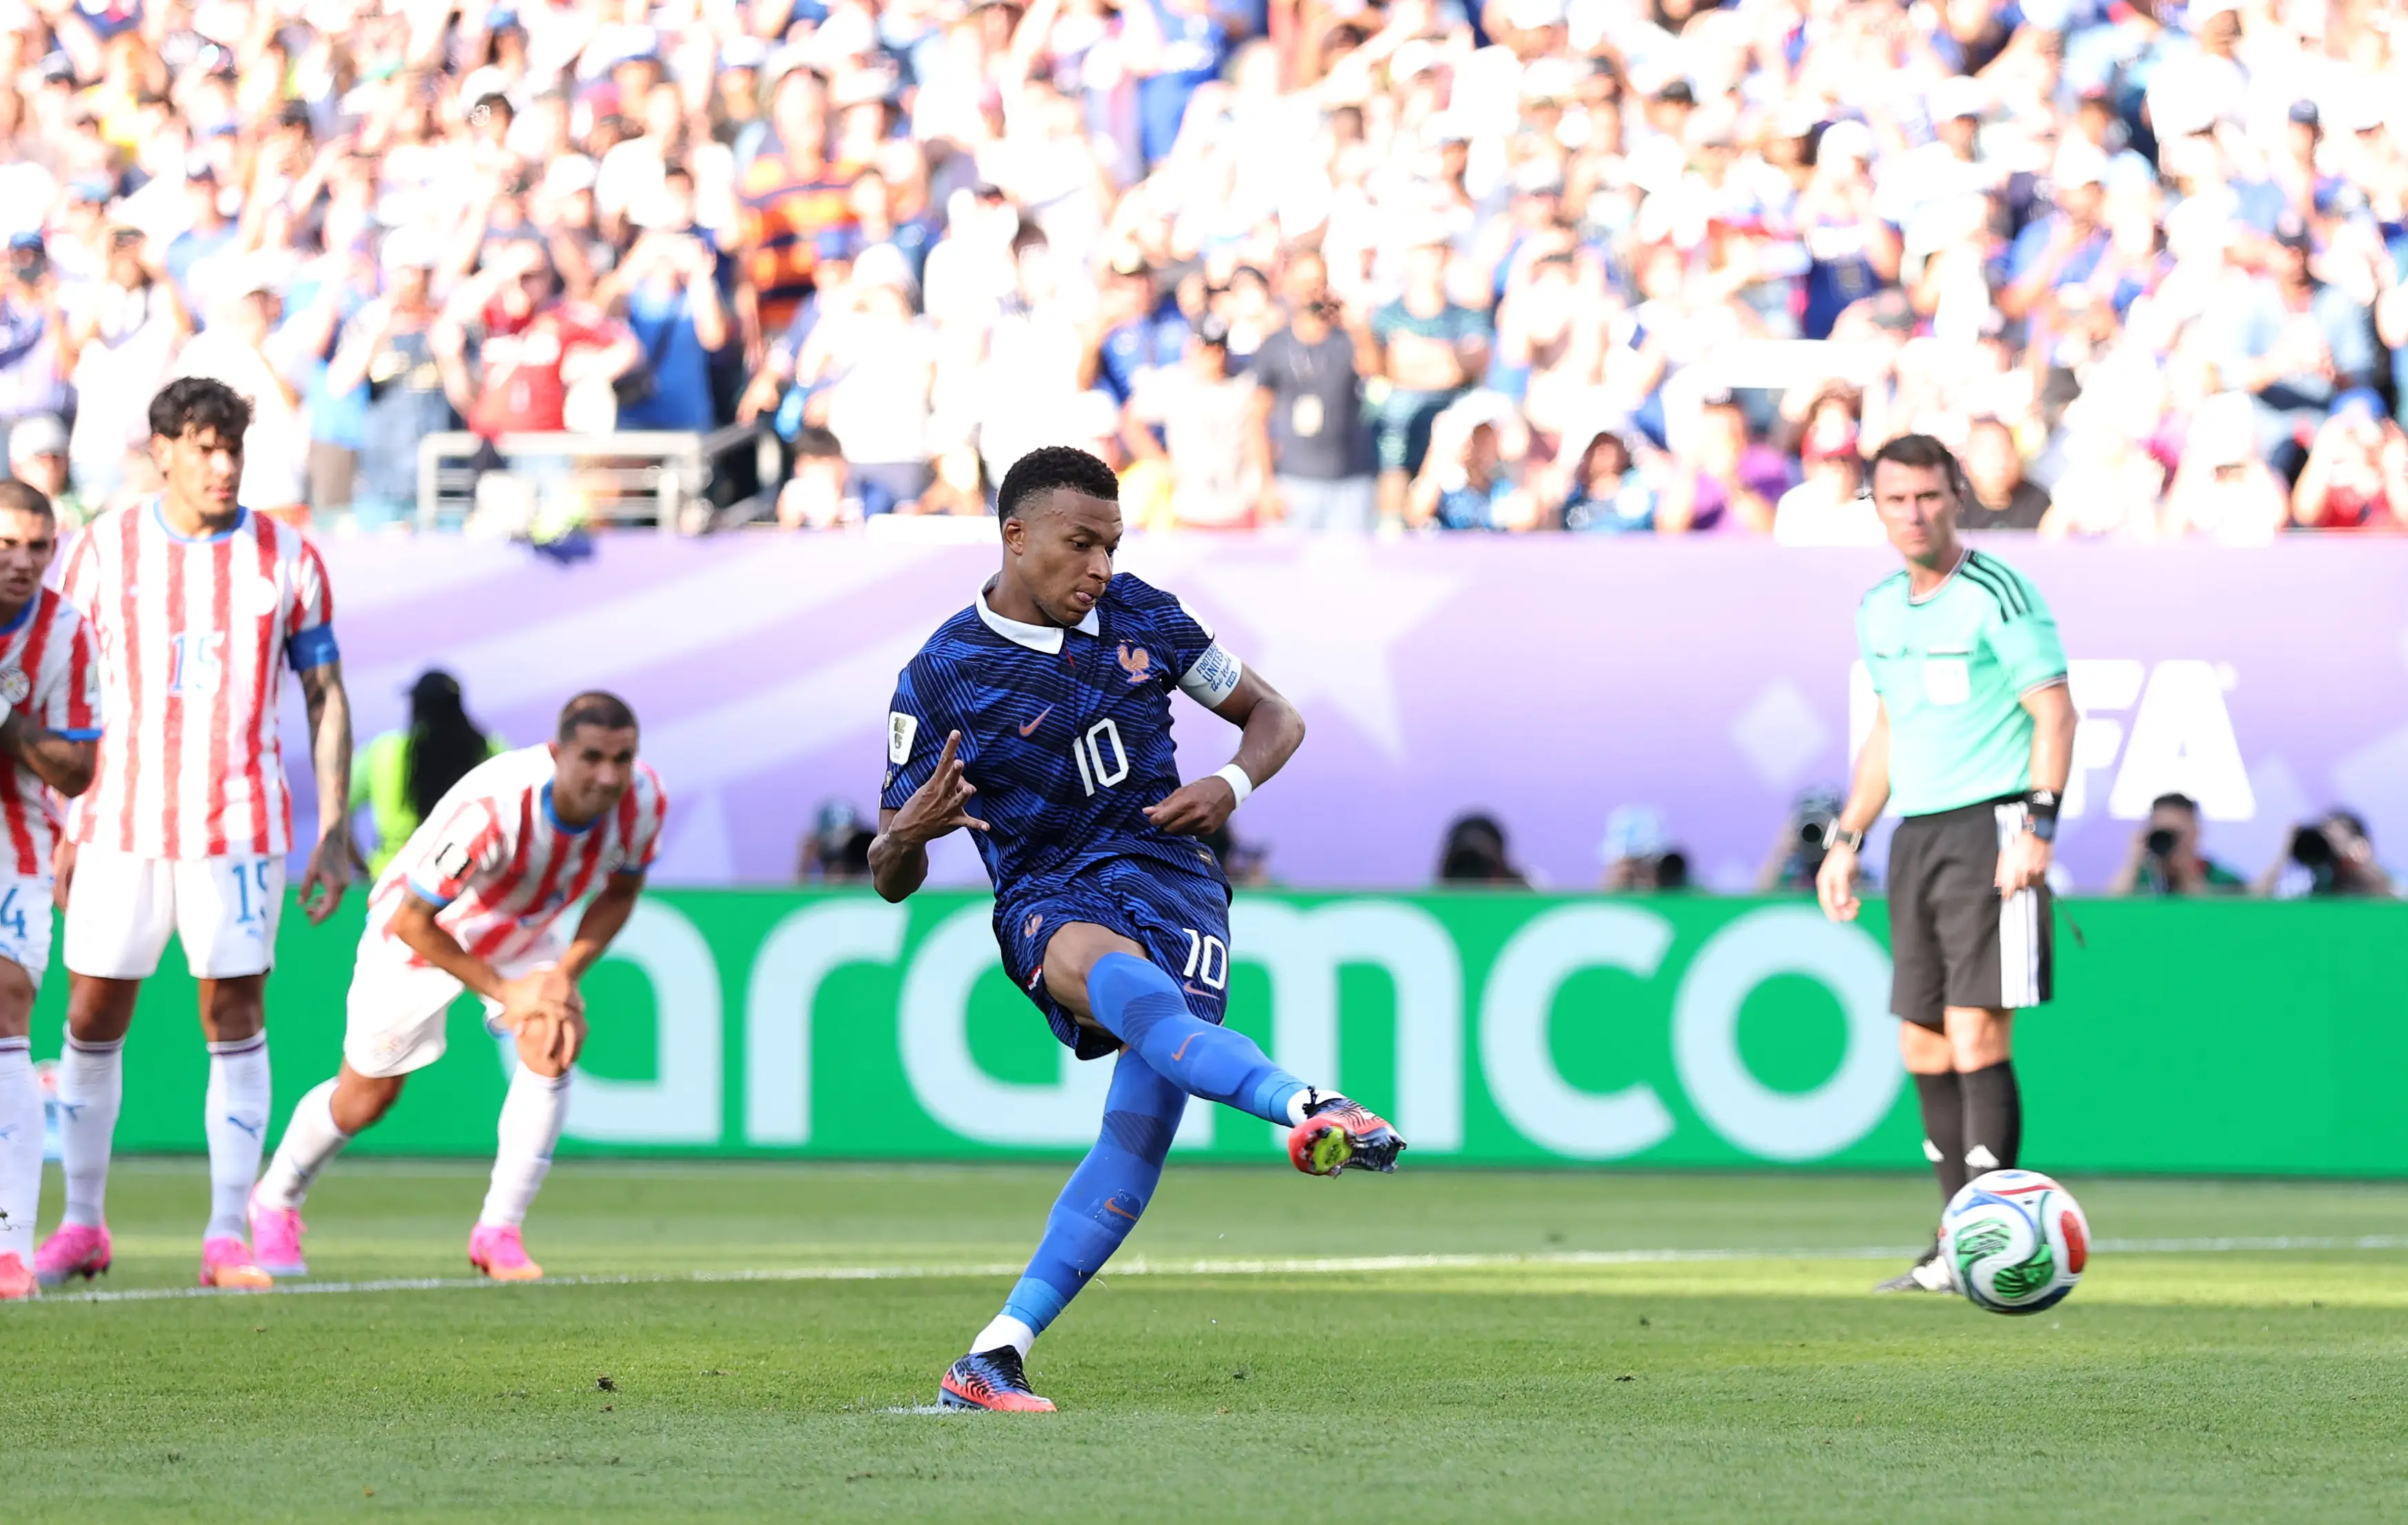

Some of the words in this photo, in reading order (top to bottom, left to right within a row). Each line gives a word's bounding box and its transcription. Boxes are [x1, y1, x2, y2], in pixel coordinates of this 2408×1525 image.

[172, 634, 221, 691] 15
[1202, 648, 1223, 683] UNITES
[1210, 677, 1223, 692] the
[1073, 718, 1129, 797] 10
[1849, 659, 2256, 819] FA
[1183, 927, 1227, 990] 10
[497, 896, 1913, 1160] aramco
